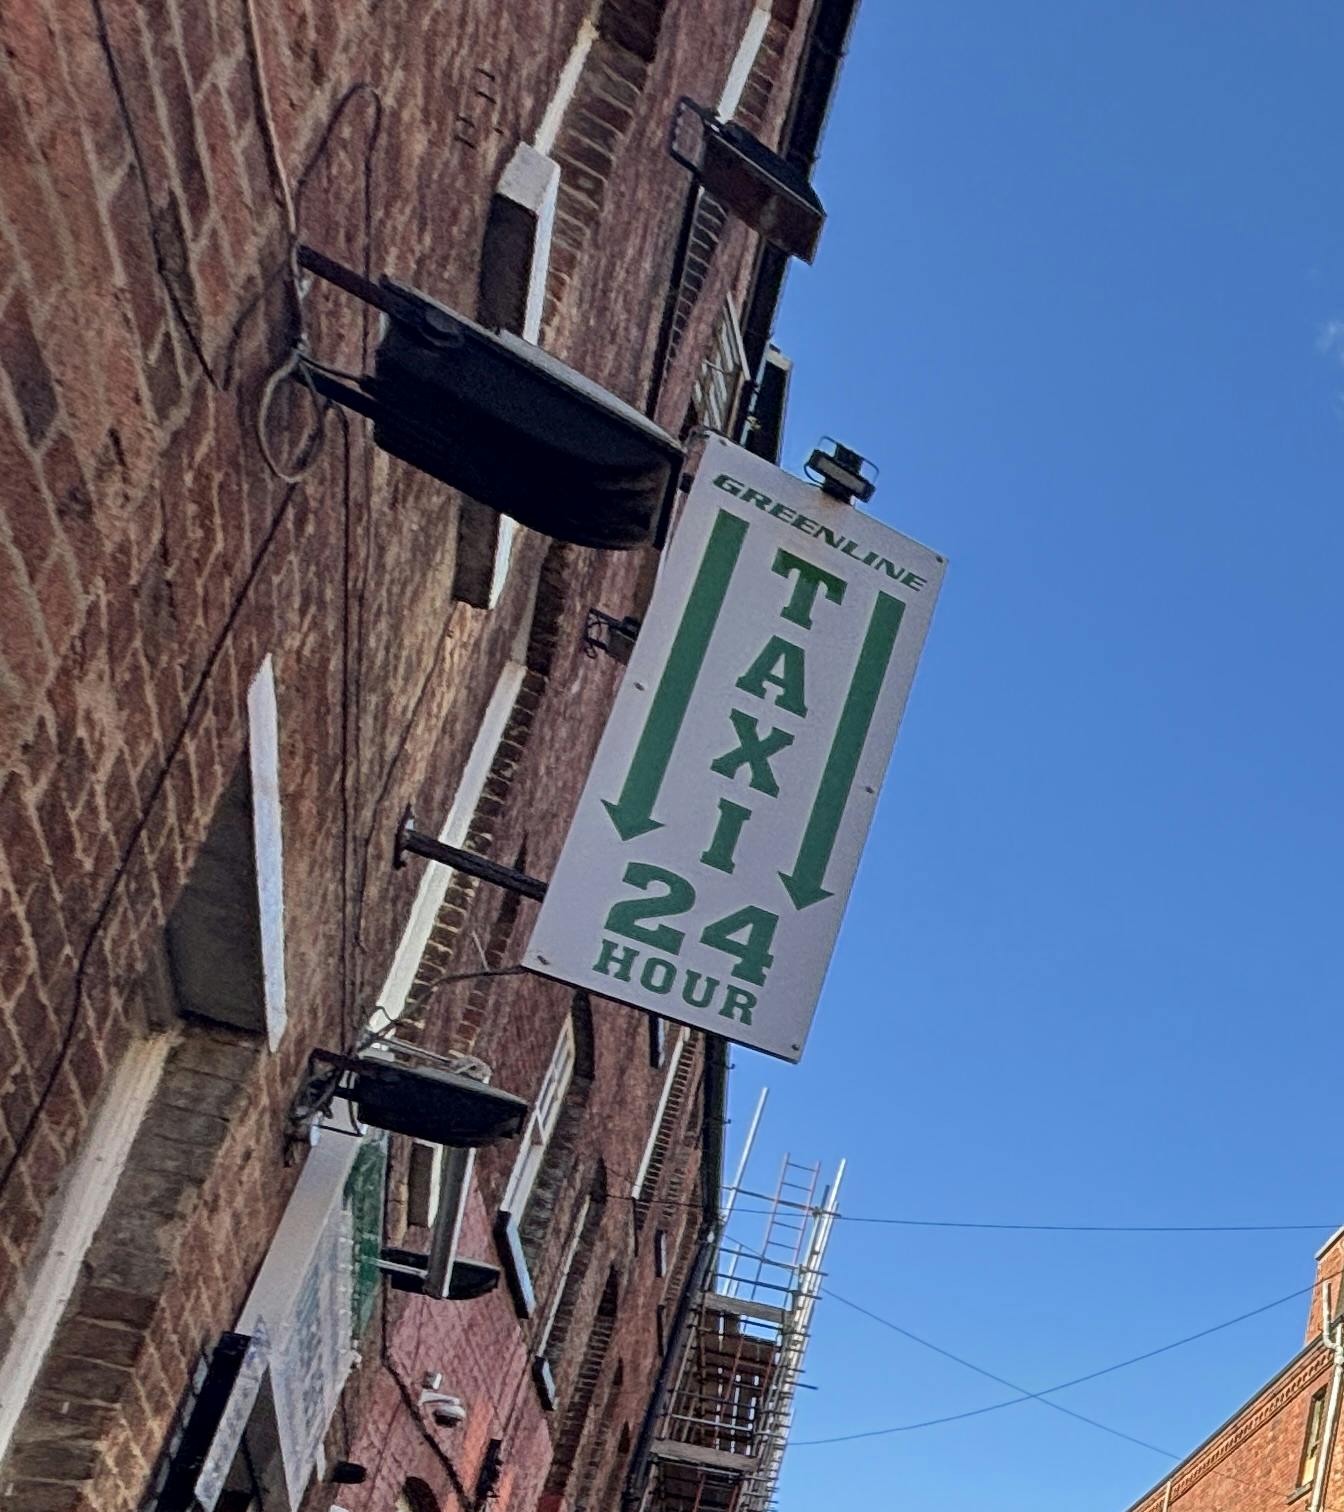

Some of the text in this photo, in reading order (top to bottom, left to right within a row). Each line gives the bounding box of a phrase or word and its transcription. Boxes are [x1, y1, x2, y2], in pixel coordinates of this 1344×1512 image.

[711, 473, 929, 592] GREENLINE
[700, 548, 847, 874] TAXI
[591, 938, 760, 1026] HOUR
[603, 861, 780, 987] 24
